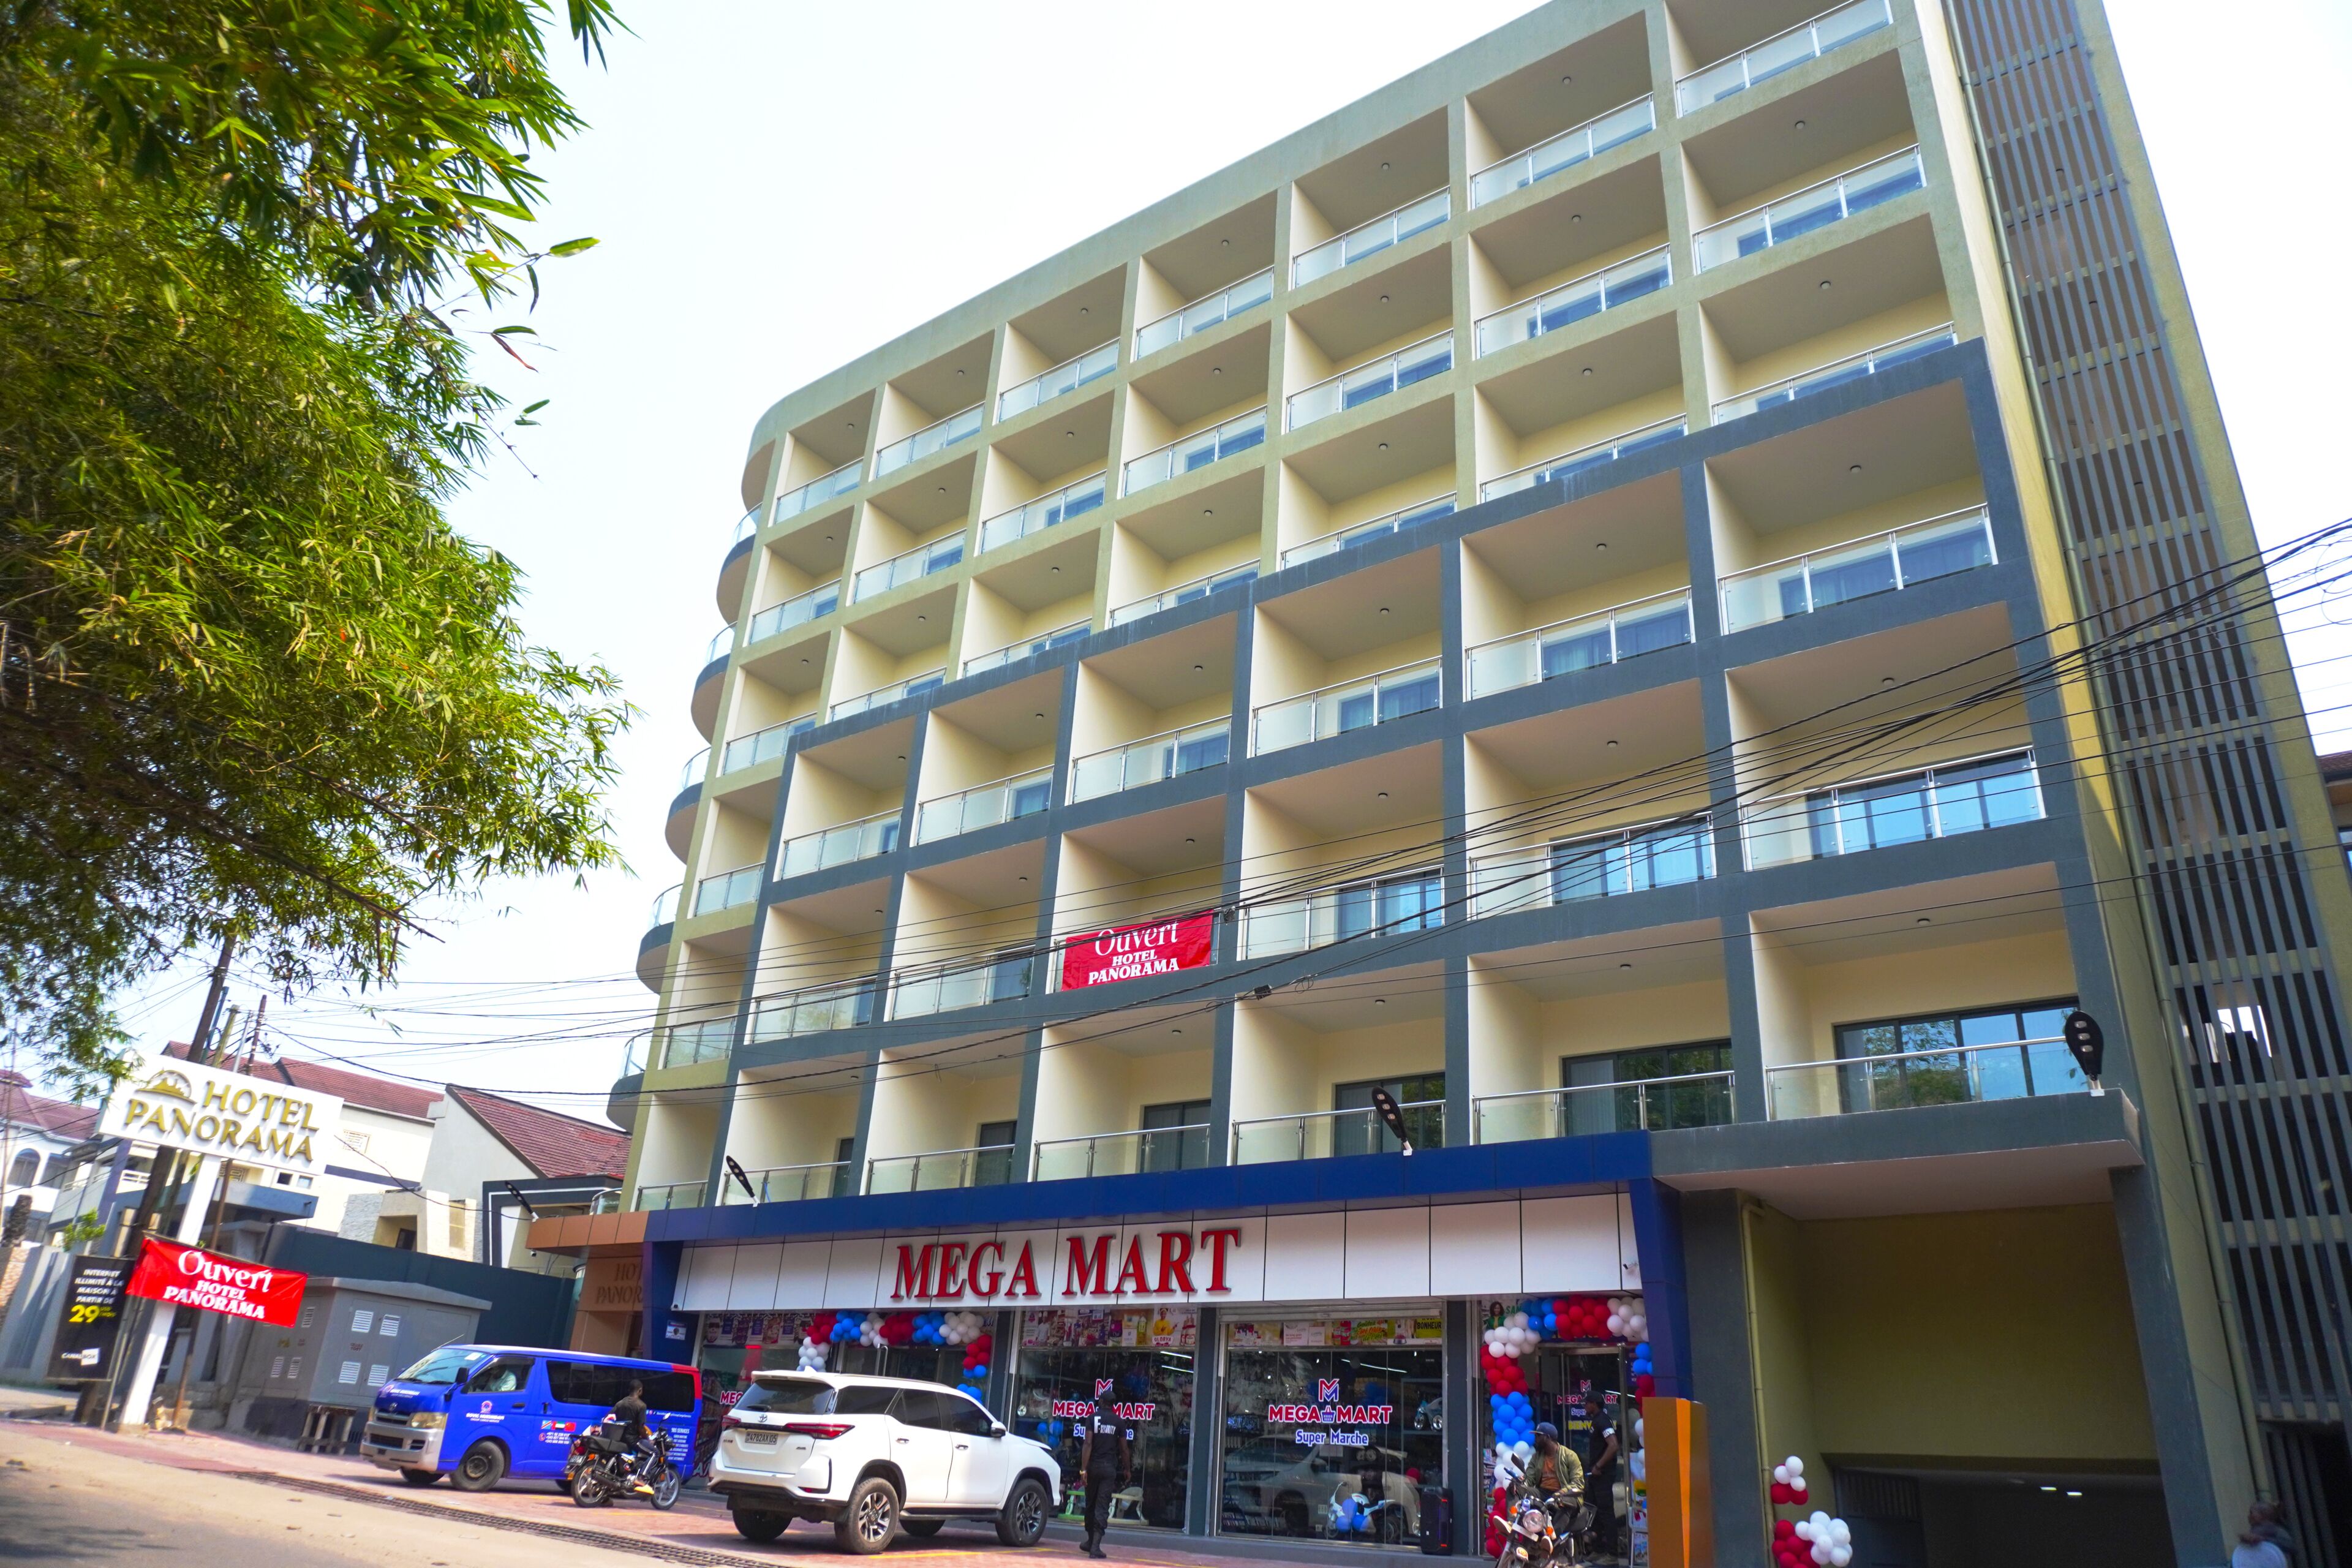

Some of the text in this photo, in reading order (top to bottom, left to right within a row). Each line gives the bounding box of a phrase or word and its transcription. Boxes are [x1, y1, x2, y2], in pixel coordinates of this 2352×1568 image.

[1095, 921, 1179, 956] Ouvert
[1112, 949, 1158, 967] HOTEL
[1088, 957, 1179, 985] PANORAMA
[203, 1080, 320, 1131] HOTEL
[124, 1098, 314, 1163] PANORAMA
[178, 1250, 273, 1292] Ouvert
[891, 1229, 1242, 1299] MEGA MART
[195, 1280, 246, 1300] HOTEL
[162, 1286, 265, 1319] PANORAMA
[69, 1304, 100, 1323] 29
[720, 1390, 743, 1405] ME
[1052, 1401, 1095, 1417] MEGA
[1268, 1404, 1393, 1424] MEGA MART
[1570, 1408, 1586, 1417] Super
[1295, 1428, 1369, 1447] Super Marche
